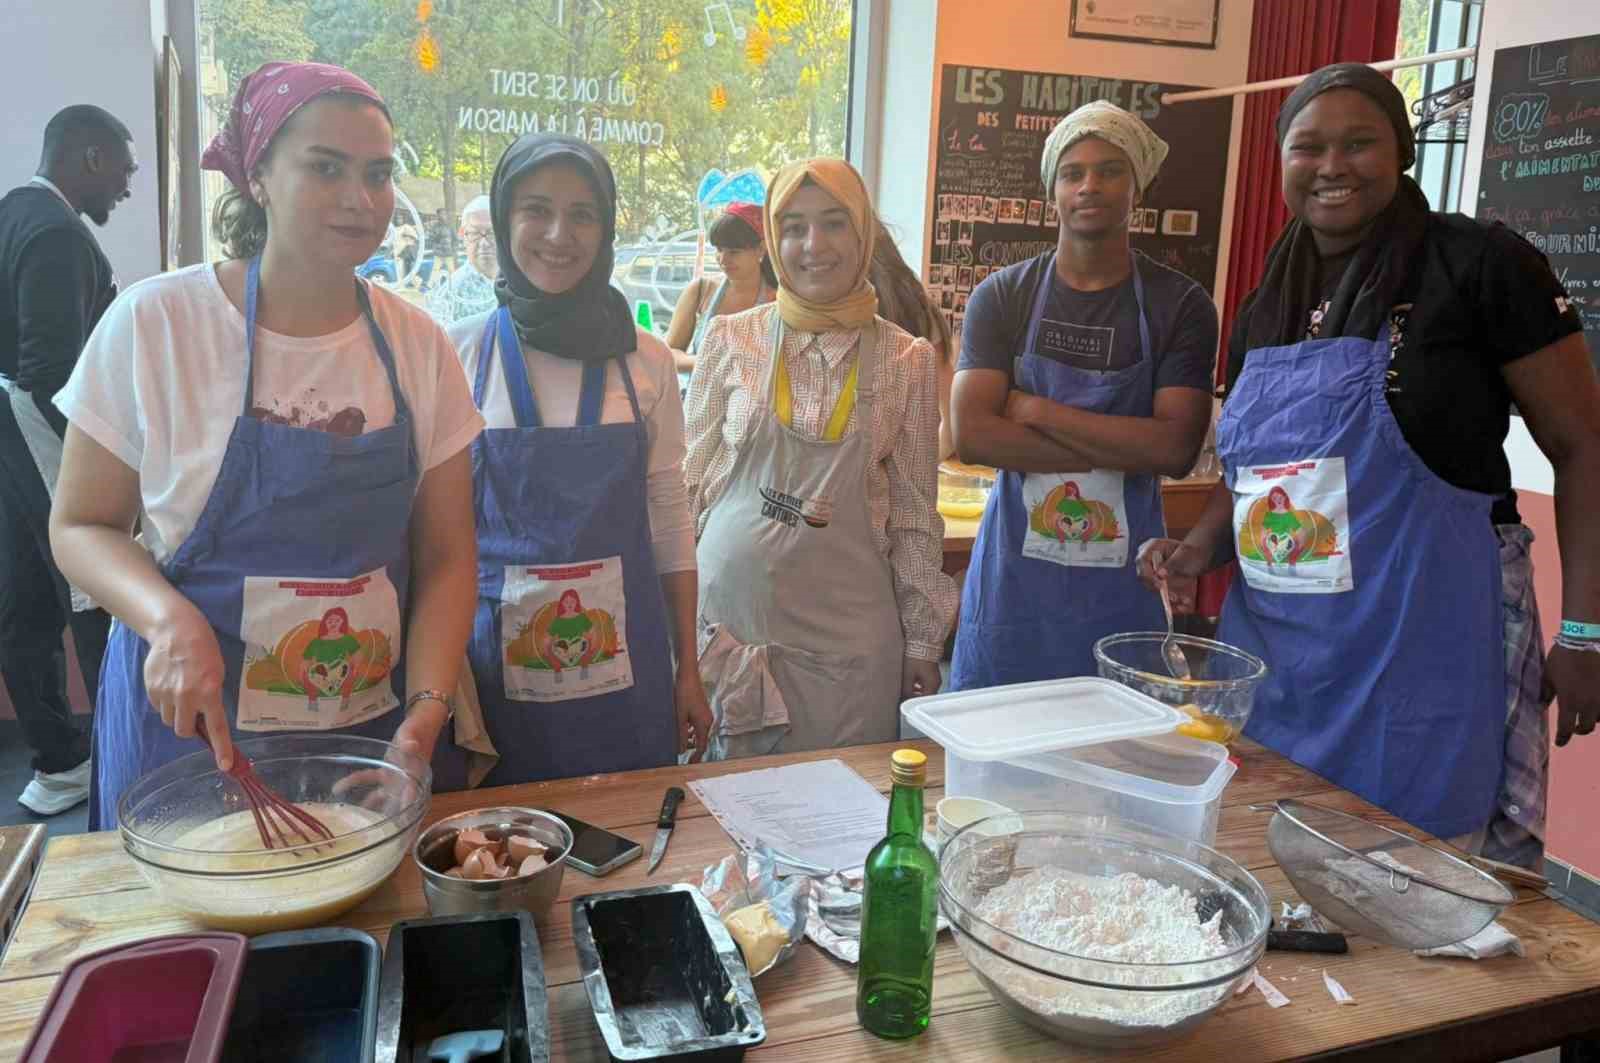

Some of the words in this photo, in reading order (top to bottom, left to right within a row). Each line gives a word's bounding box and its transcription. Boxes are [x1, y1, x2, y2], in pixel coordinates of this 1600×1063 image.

[955, 67, 1004, 105] LES
[976, 112, 1000, 128] DES
[1498, 100, 1545, 137] 80%
[1544, 128, 1593, 150] assiette
